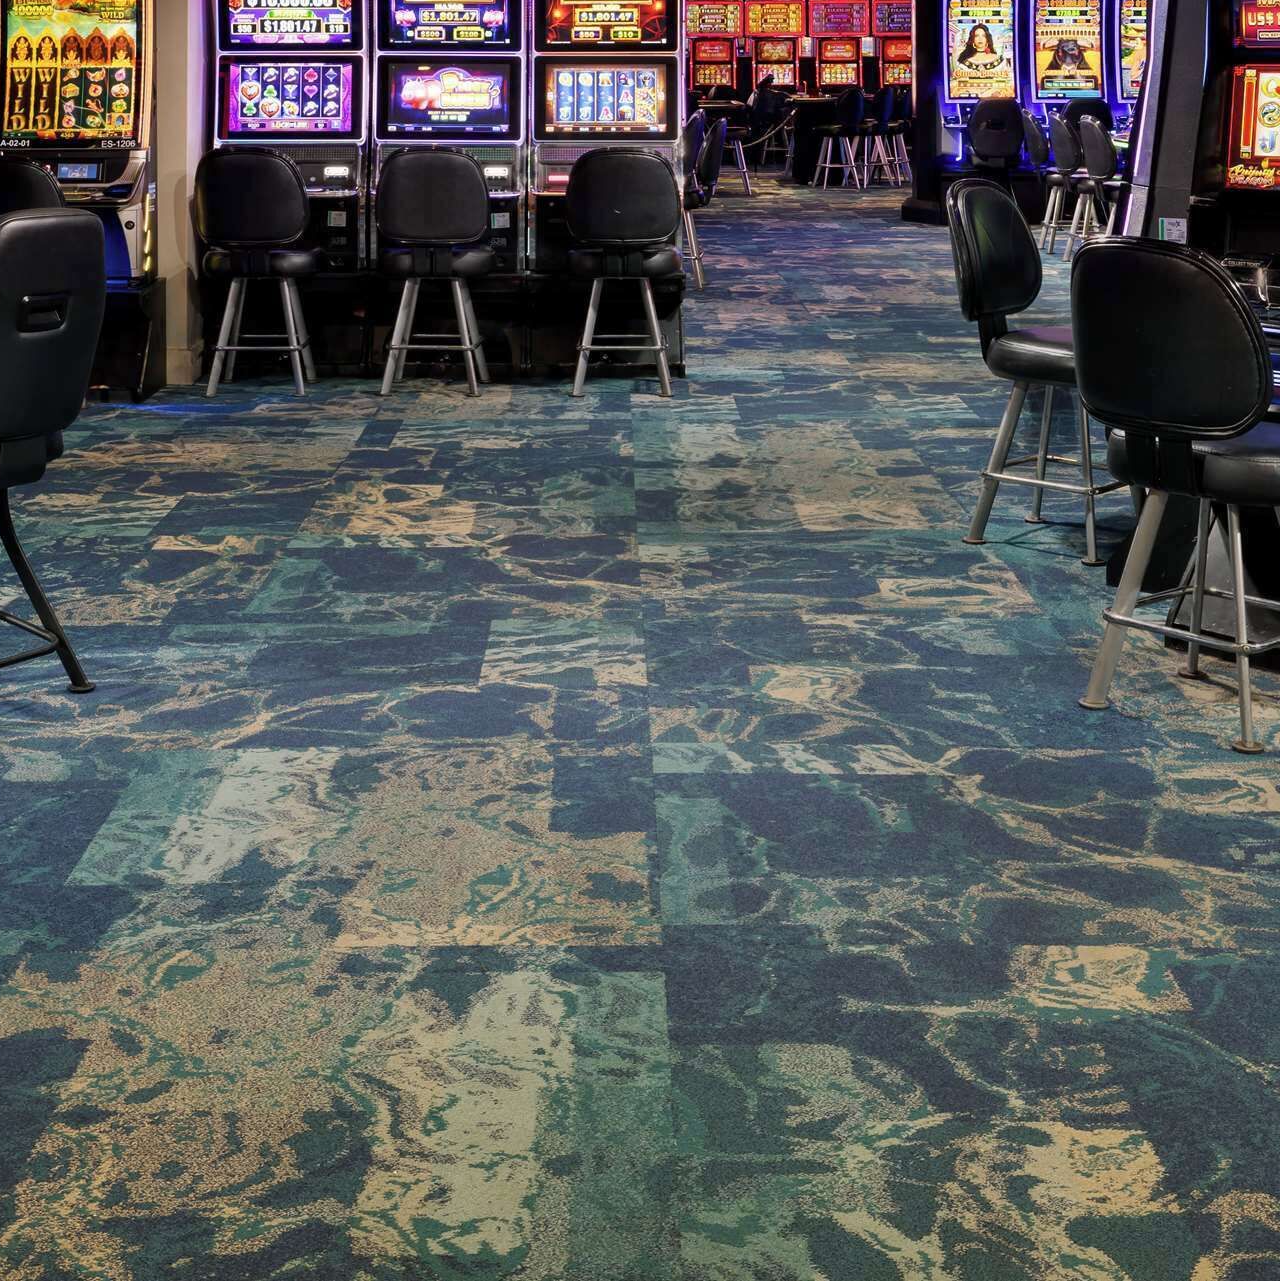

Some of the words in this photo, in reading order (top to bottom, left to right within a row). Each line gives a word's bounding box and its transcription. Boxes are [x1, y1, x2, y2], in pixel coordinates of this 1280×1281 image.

[101, 11, 125, 20] WILD
[422, 11, 477, 22] $1,801.47
[263, 20, 318, 34] $1,801.47
[10, 68, 30, 130] WILD
[35, 68, 55, 130] WILD
[101, 140, 136, 148] ES-1206
